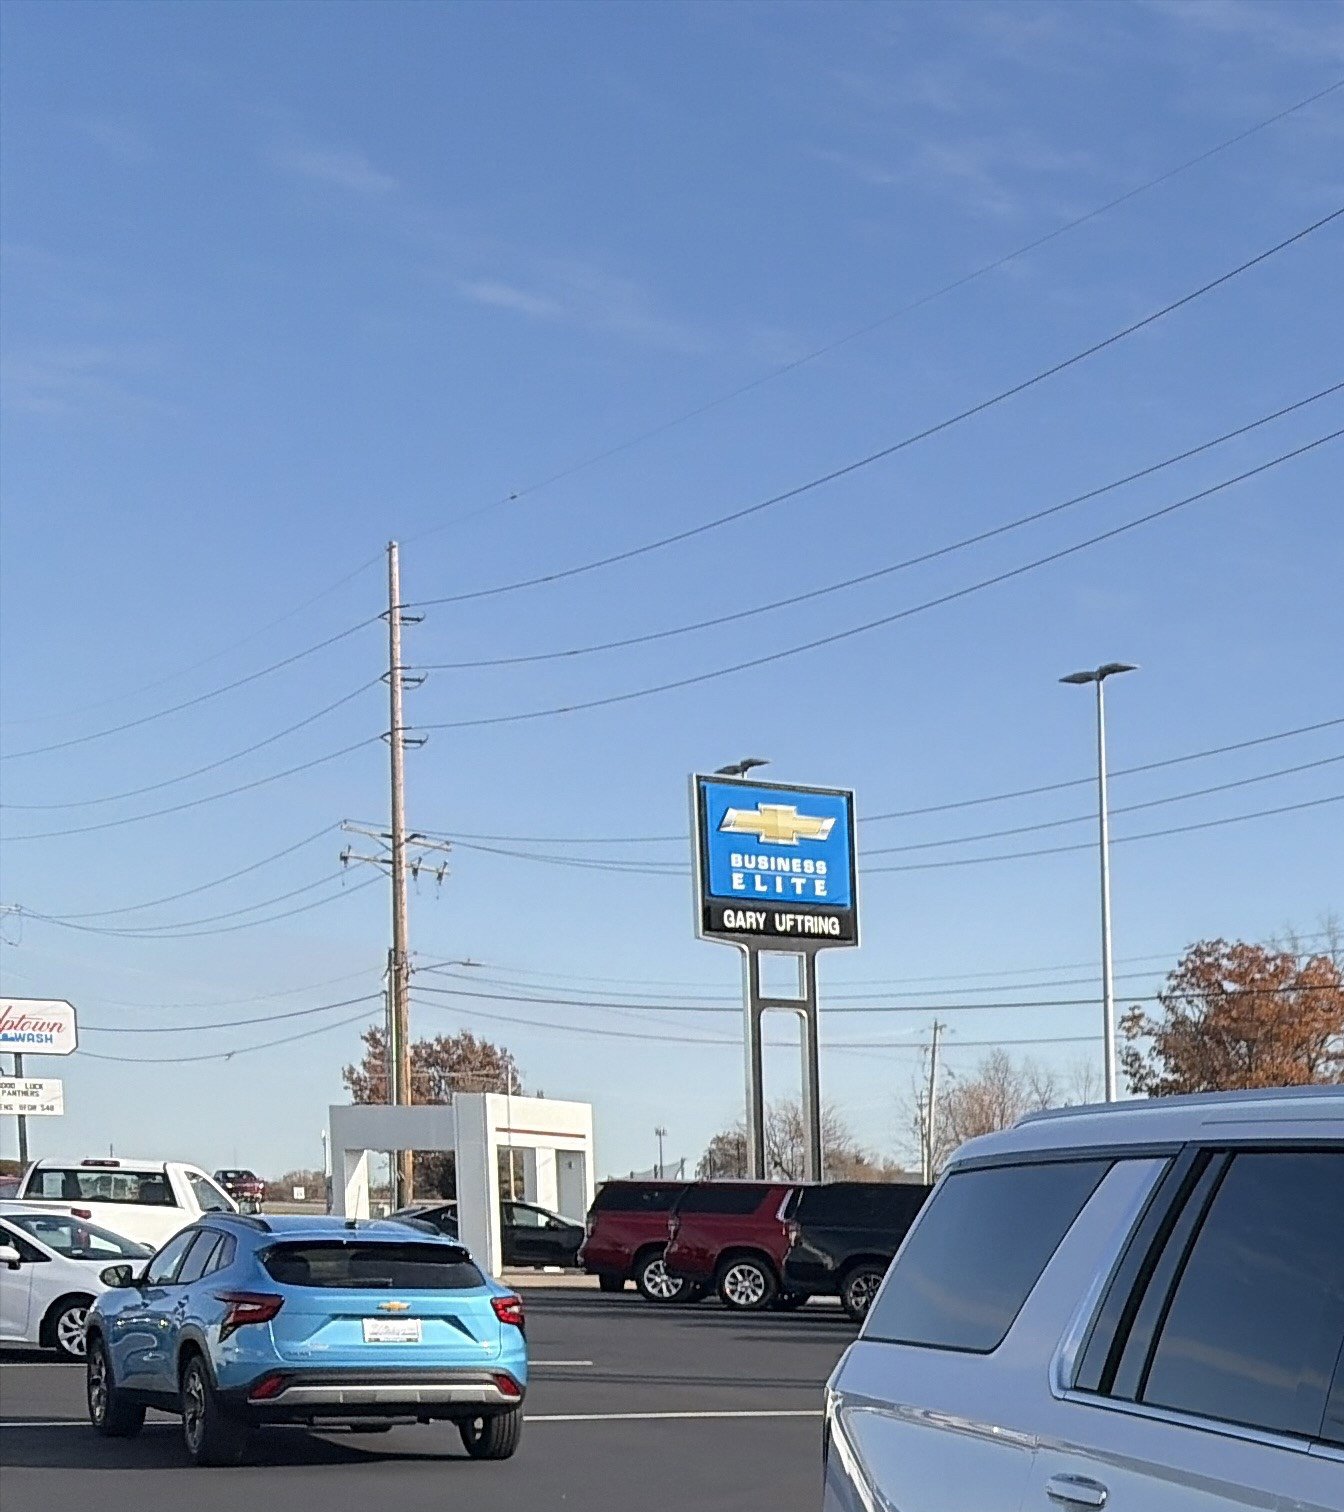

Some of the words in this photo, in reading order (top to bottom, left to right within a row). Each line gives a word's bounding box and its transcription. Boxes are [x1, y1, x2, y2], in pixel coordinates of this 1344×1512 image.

[731, 853, 827, 875] BUSINESS
[732, 872, 827, 896] ELITE
[723, 909, 766, 930] GARY
[775, 913, 839, 935] UFTRING
[14, 1032, 53, 1044] WASH
